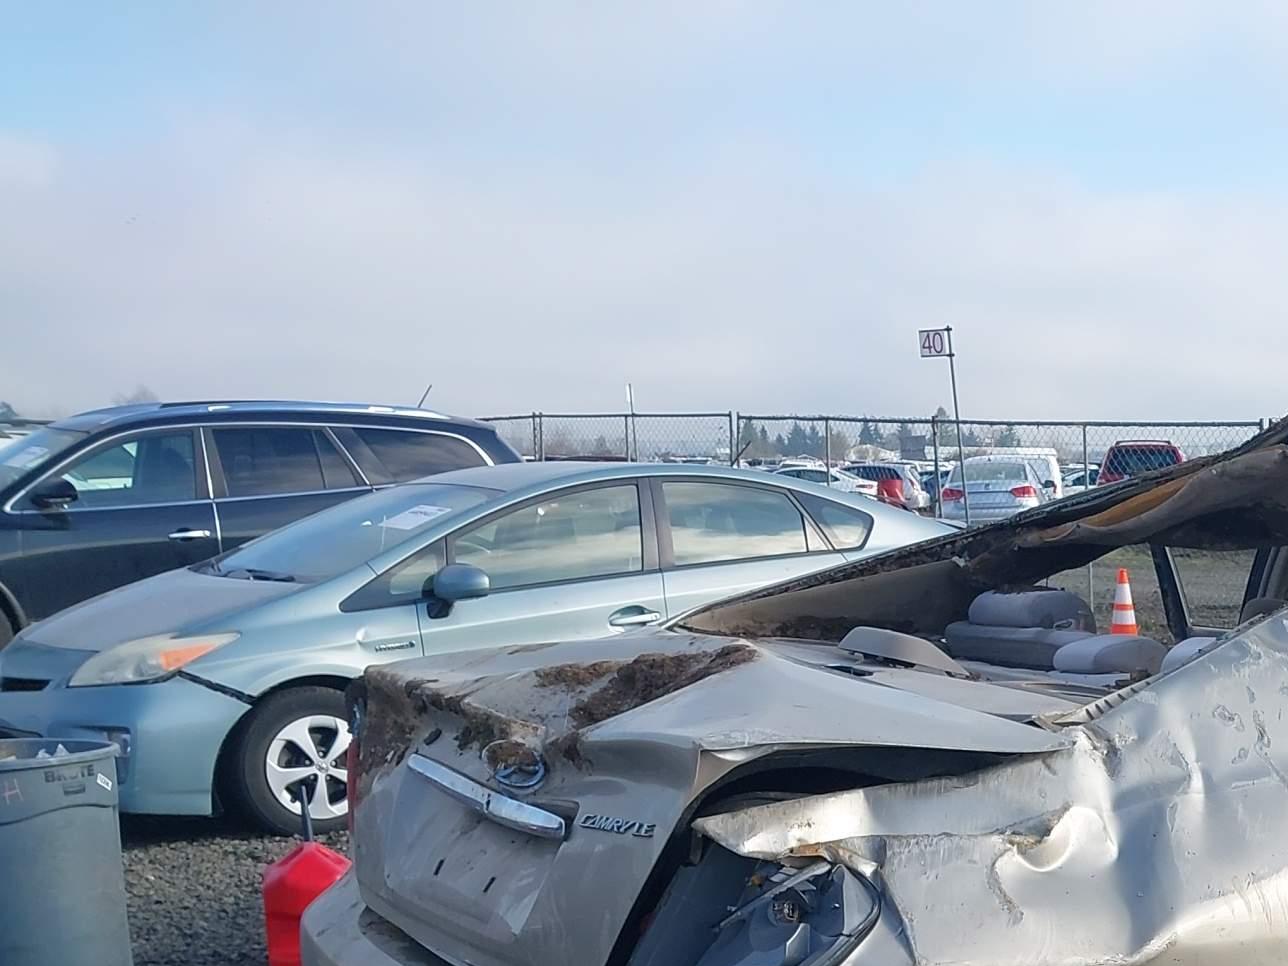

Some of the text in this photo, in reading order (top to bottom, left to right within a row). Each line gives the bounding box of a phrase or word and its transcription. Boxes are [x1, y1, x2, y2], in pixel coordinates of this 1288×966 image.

[922, 332, 944, 354] 40
[579, 813, 656, 838] CAMRY LE
